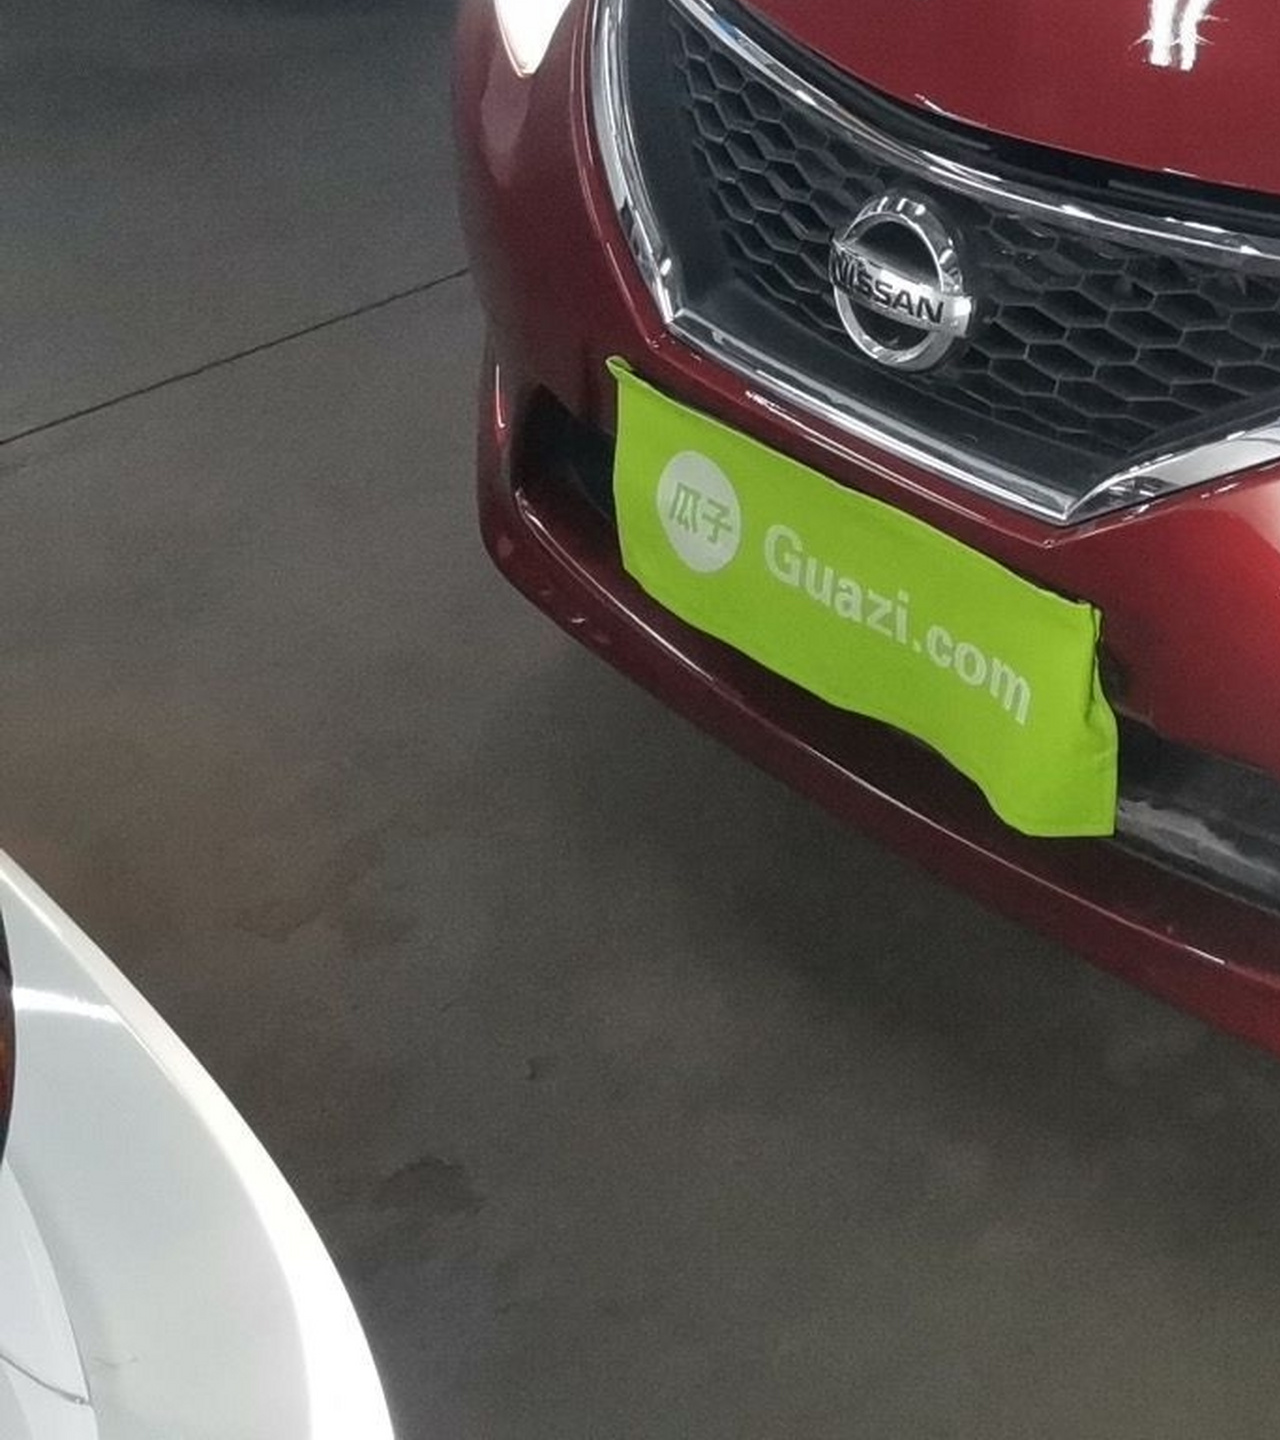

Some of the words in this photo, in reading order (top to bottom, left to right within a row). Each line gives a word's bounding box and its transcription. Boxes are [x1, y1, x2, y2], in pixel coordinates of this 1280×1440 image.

[832, 250, 944, 324] NISSAN
[669, 481, 732, 544] 瓜子
[764, 524, 1031, 726] Guazi.com
